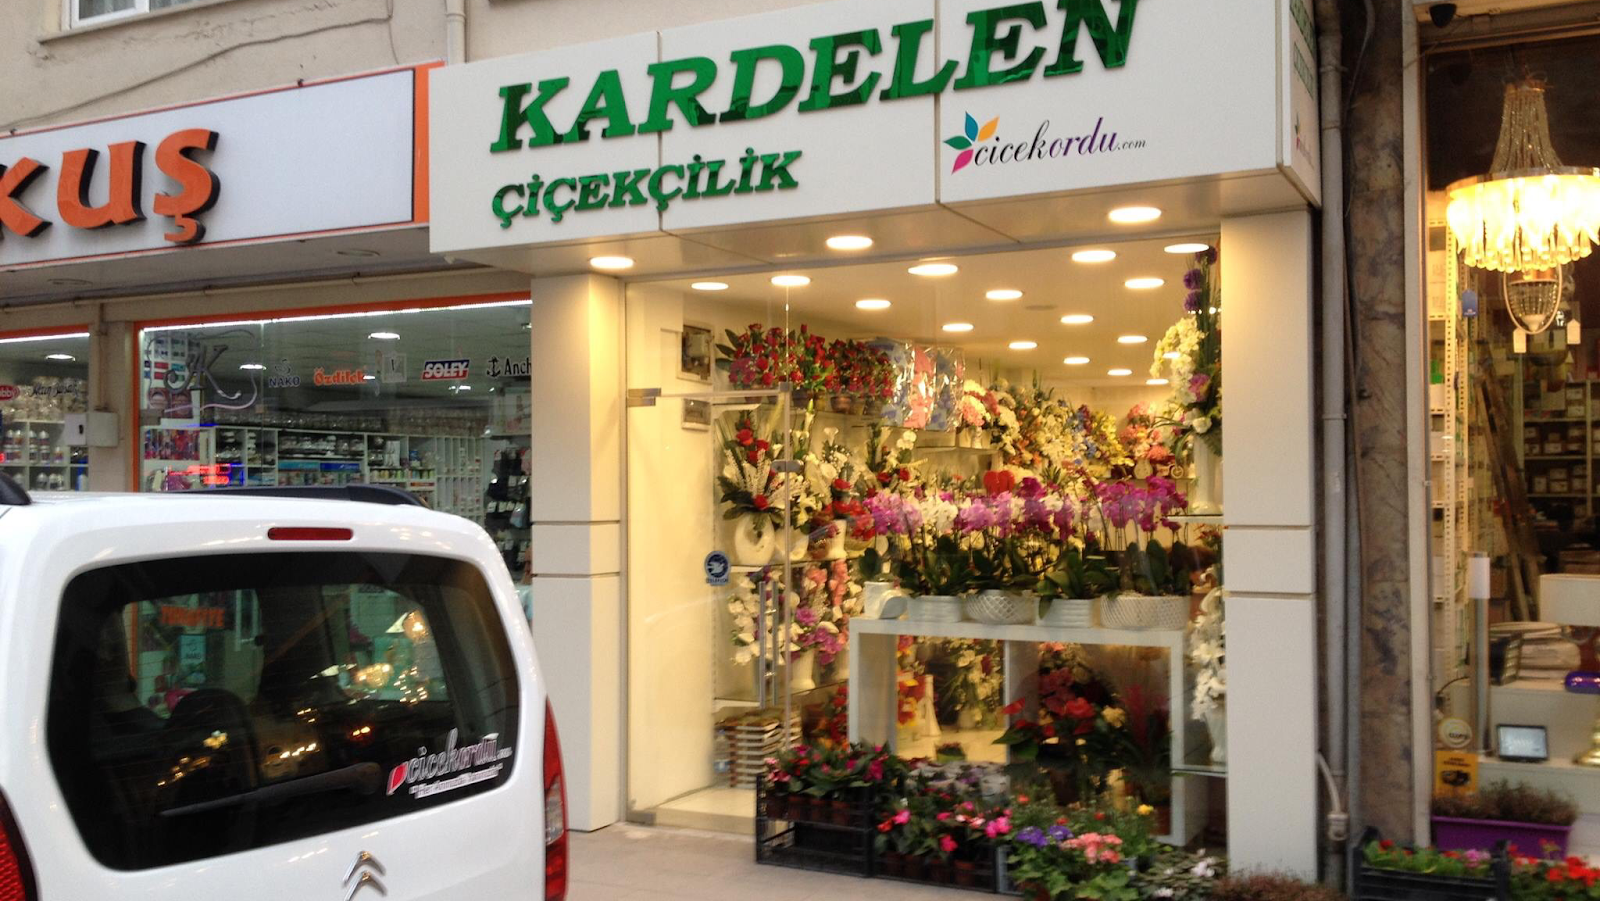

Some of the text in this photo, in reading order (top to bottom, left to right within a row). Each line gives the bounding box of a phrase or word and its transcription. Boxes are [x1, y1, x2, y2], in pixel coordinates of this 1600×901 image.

[489, 0, 1139, 154] KARDELEN
[974, 117, 1147, 167] cicekordu.com
[491, 147, 802, 229] ÇİÇEKÇİLİK
[269, 375, 301, 388] NAKO
[424, 361, 468, 378] SOLEY
